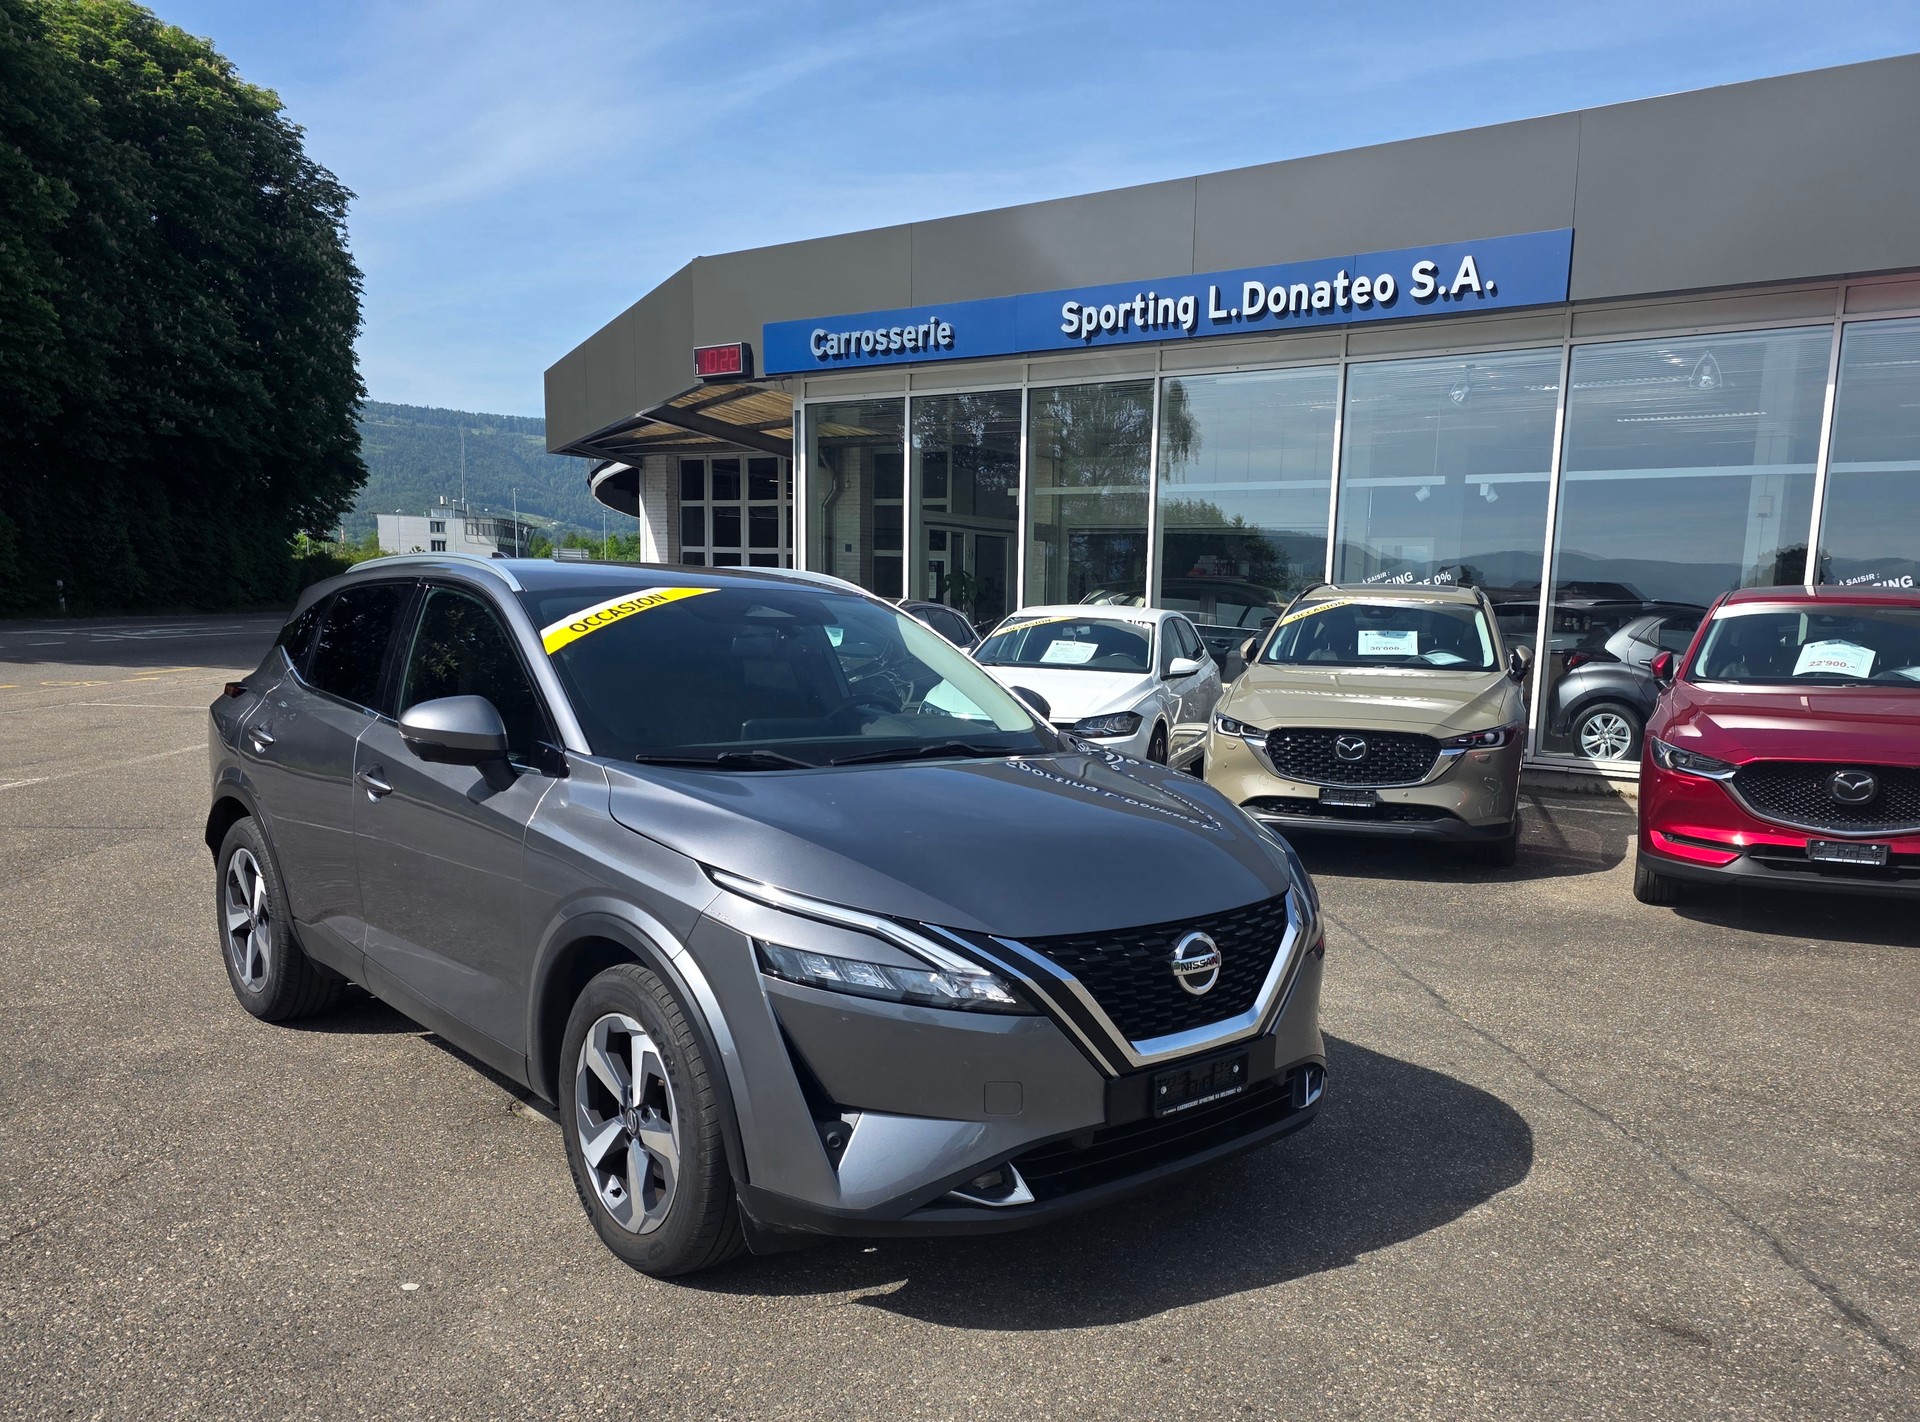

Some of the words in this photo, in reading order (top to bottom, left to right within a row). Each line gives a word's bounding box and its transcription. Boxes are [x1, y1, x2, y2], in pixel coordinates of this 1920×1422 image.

[1060, 291, 1196, 339] Sporting
[1209, 269, 1395, 319] L.Donateo
[1409, 255, 1495, 298] S.A.
[810, 316, 952, 357] Carrosserie
[1846, 574, 1875, 586] SAISIR
[1872, 575, 1914, 588] ING
[569, 593, 669, 633] OCCASION
[1181, 955, 1218, 972] NISSAN
